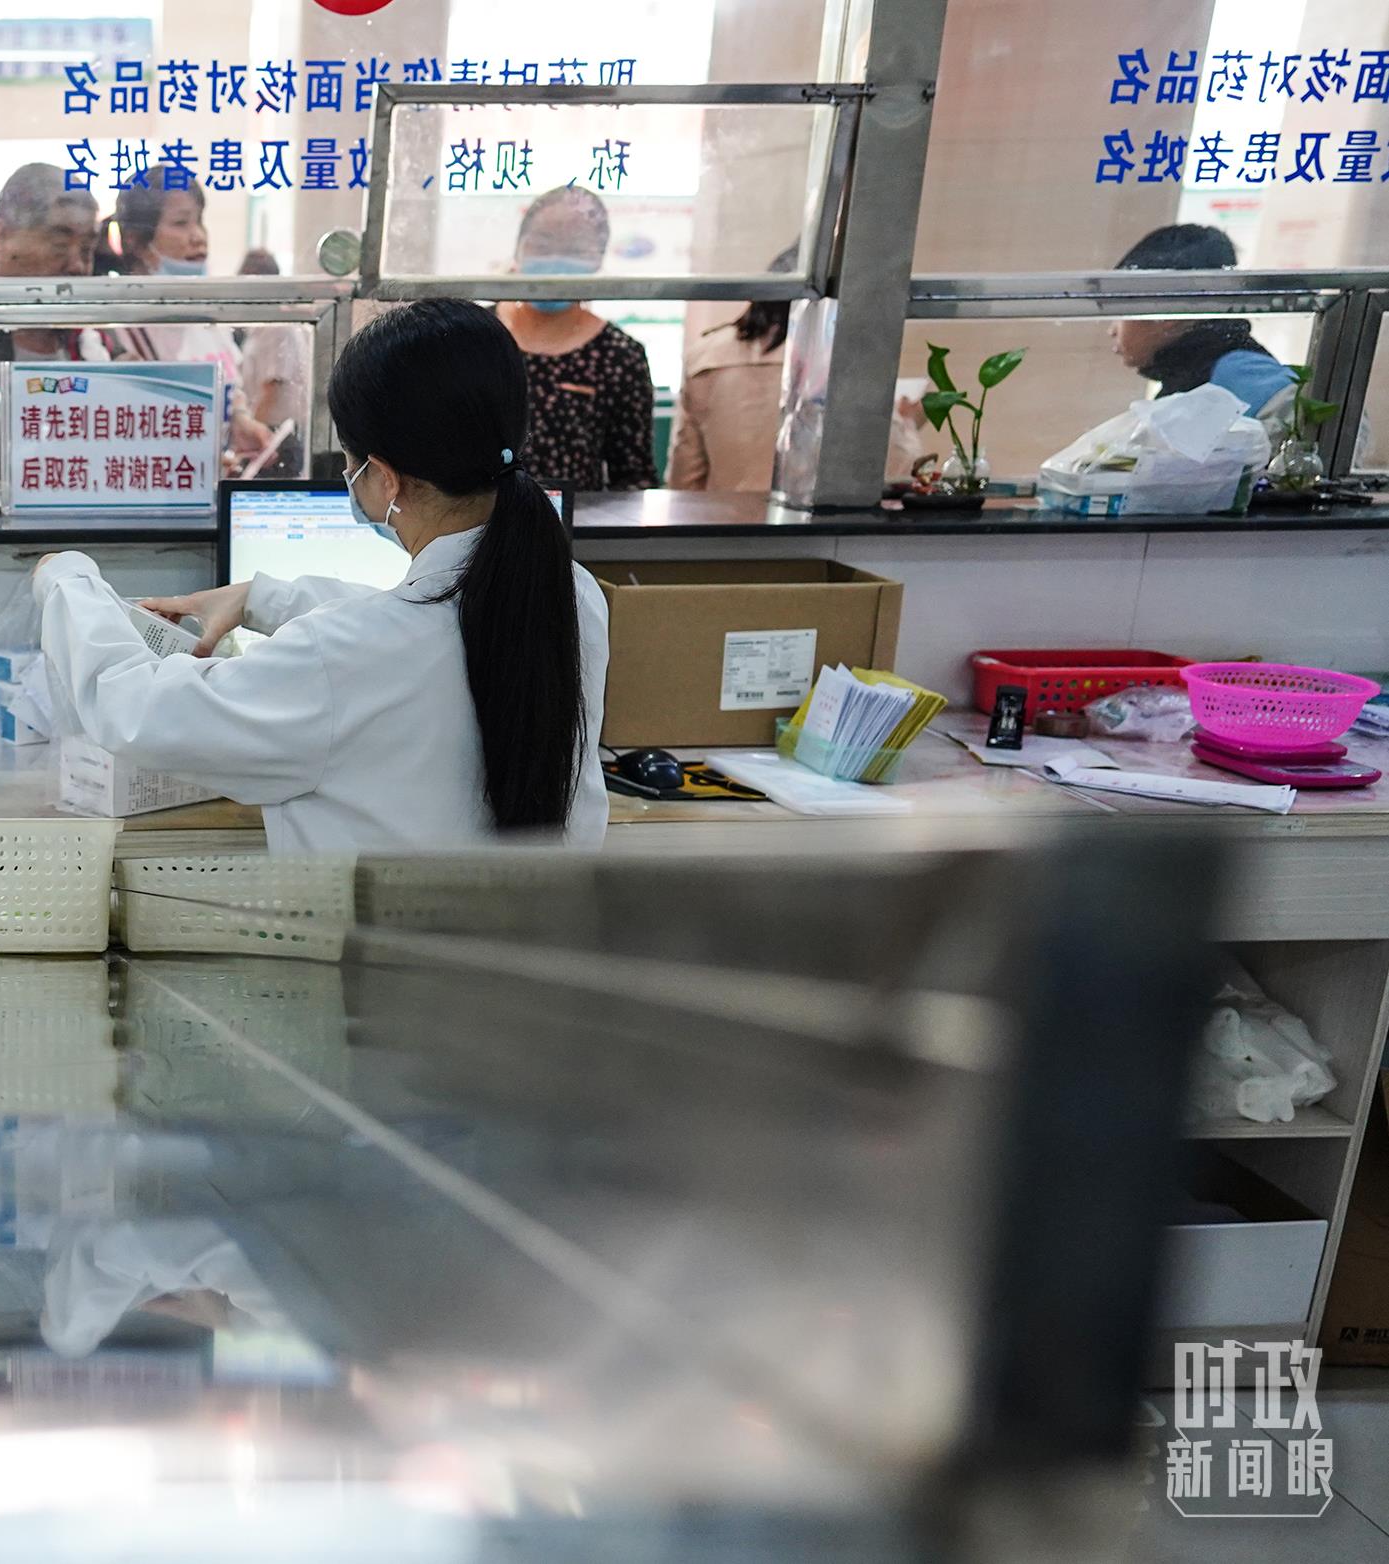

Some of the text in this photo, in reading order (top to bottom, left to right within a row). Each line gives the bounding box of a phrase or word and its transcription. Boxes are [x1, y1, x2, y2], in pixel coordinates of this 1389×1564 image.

[21, 405, 207, 440] 请先到自助机结算
